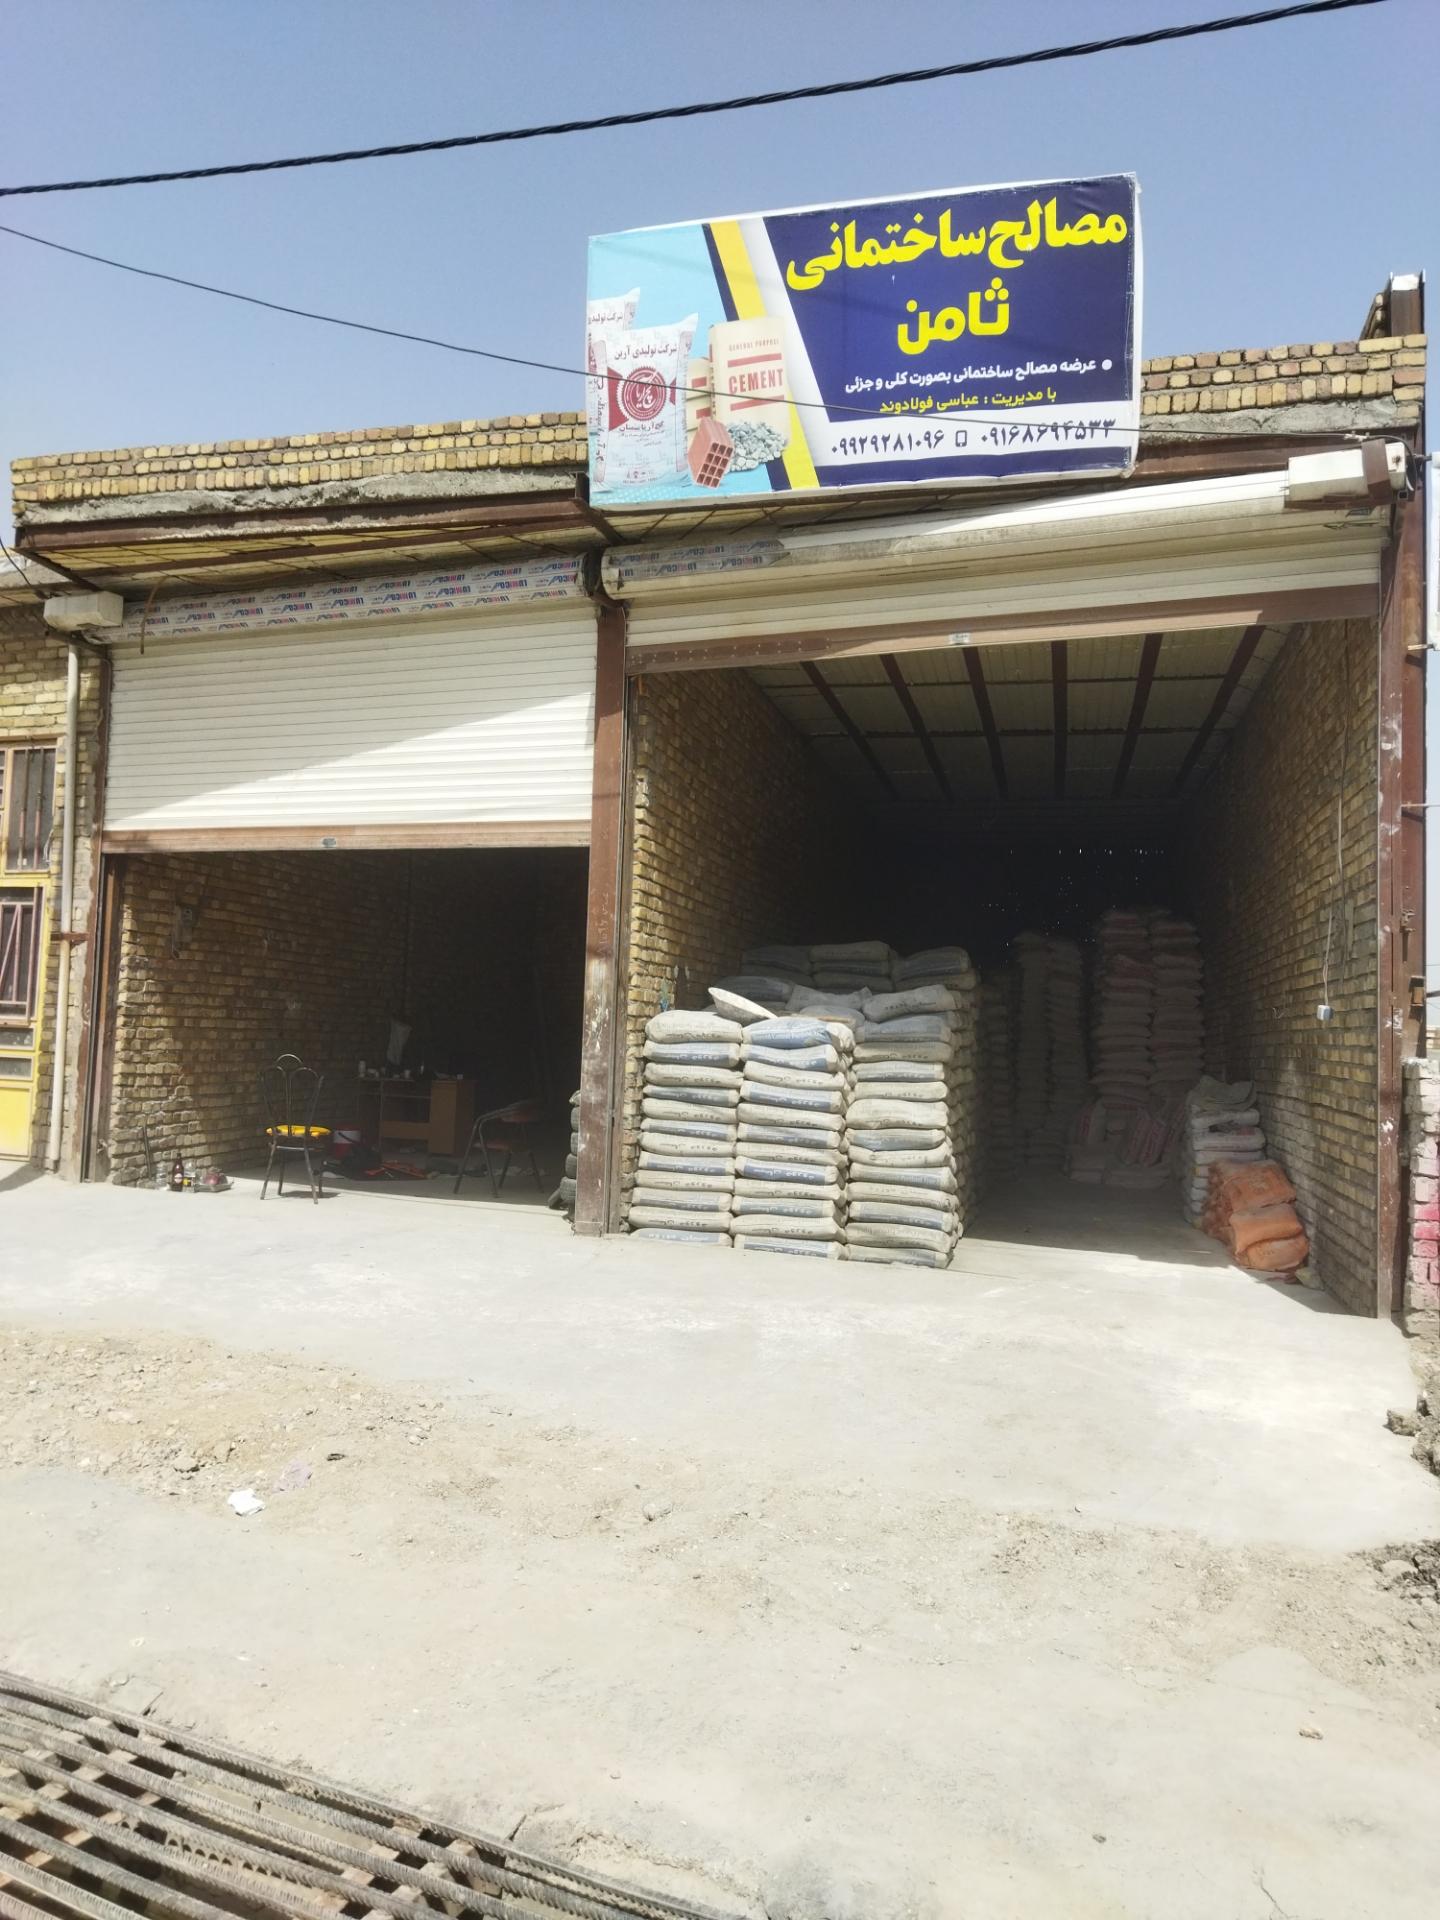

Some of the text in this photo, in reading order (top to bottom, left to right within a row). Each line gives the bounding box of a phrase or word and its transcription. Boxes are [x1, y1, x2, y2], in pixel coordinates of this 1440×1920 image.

[786, 197, 1128, 290] مصالح ساختمانی
[897, 277, 1010, 354] ثامن
[730, 369, 786, 395] CEMENT
[845, 358, 1097, 393] عرضه مصالح ساختمانی بصورت کلی و جزئی
[937, 394, 980, 412] عباسی
[991, 391, 1043, 407] مدیریت
[1046, 387, 1056, 402] با
[879, 397, 934, 415] فولادوند
